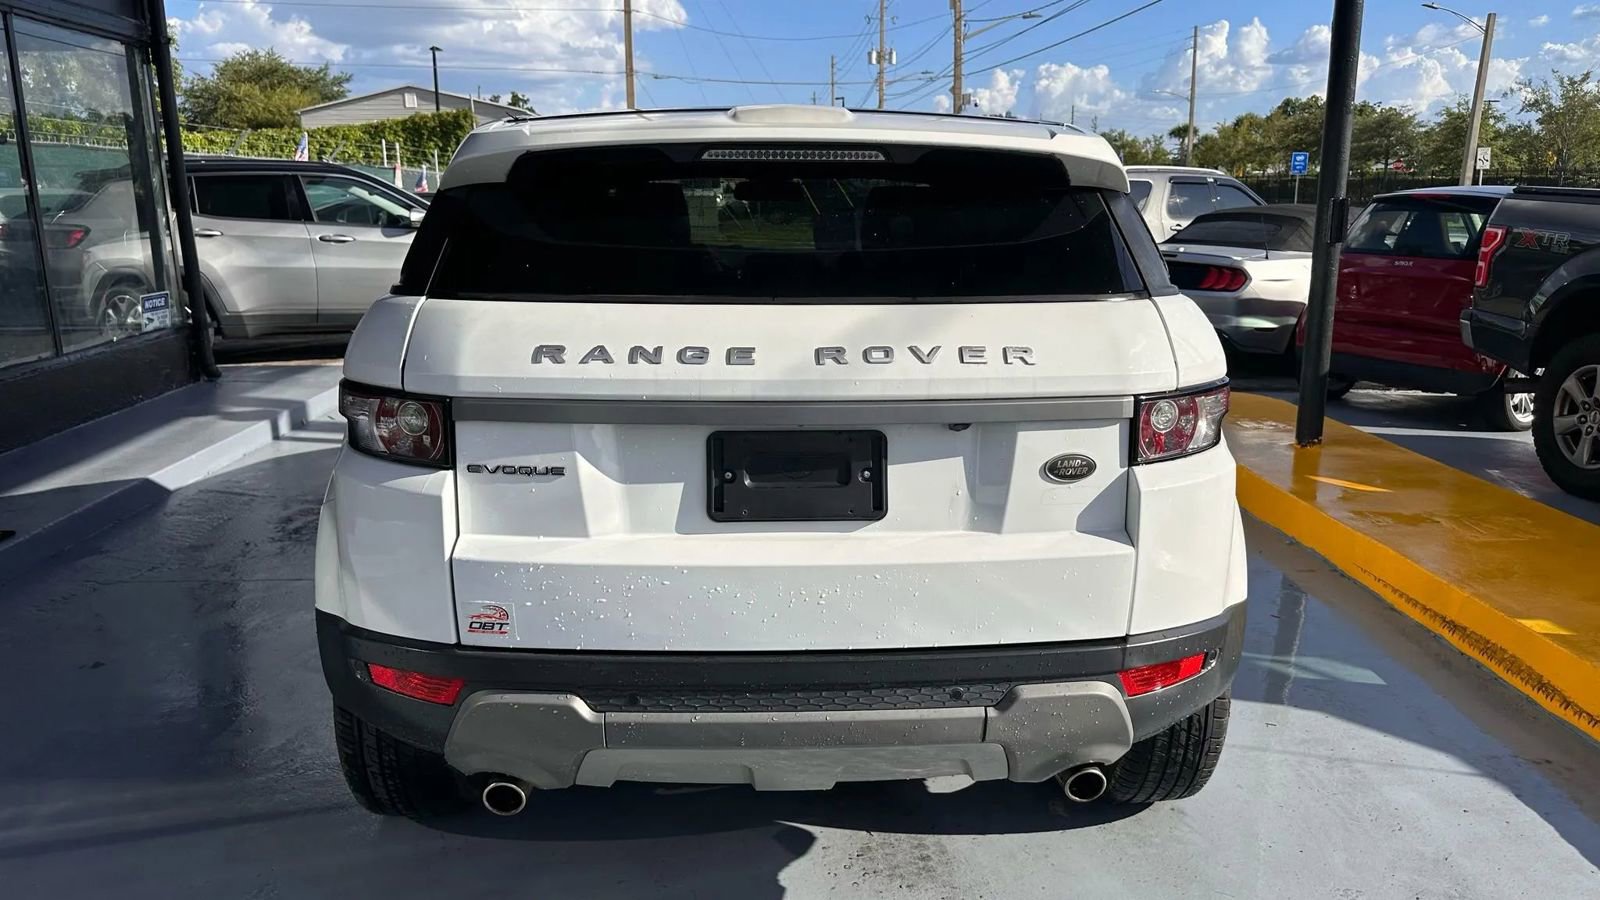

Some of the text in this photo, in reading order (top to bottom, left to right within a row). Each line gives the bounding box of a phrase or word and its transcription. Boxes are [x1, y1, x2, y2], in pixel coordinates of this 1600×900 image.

[1514, 227, 1570, 250] XTR
[144, 297, 166, 309] NOTICE
[530, 344, 1036, 366] RANGE ROVER
[466, 464, 566, 477] EVOQUE
[468, 621, 510, 631] OBT
